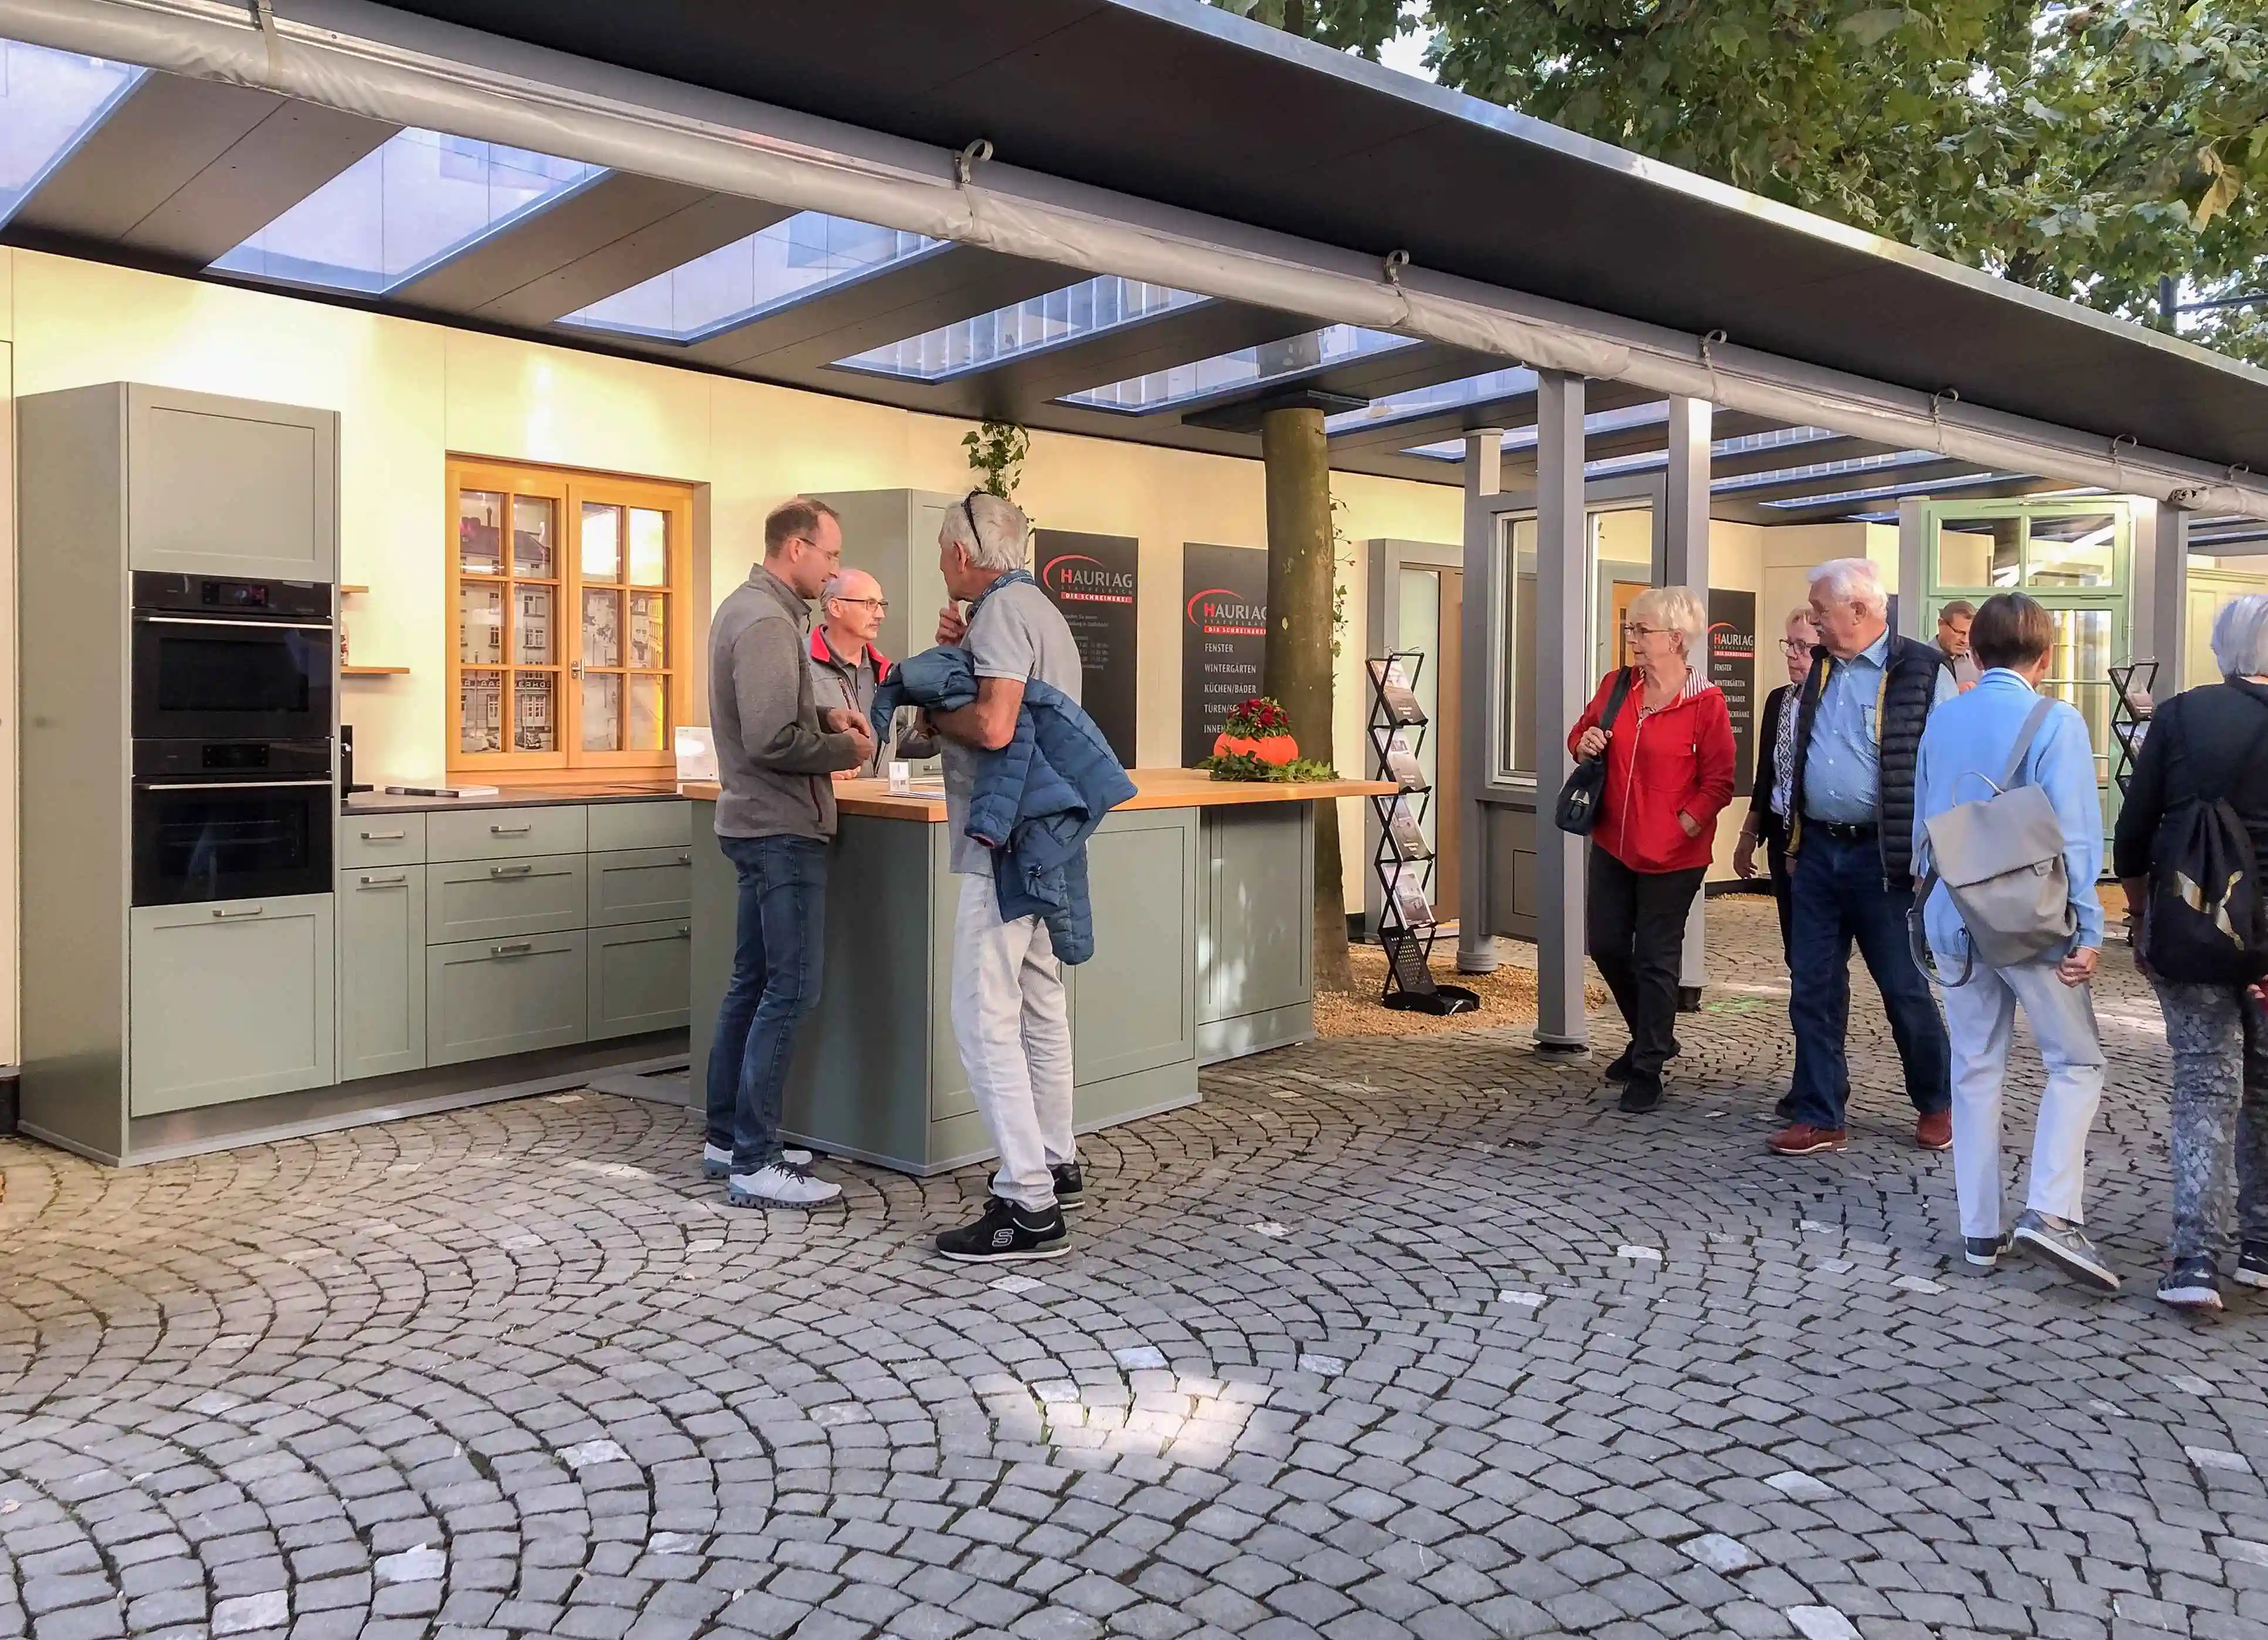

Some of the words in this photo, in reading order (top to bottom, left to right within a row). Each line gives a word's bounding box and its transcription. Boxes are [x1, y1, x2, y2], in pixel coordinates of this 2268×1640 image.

[1061, 568, 1110, 587] HAURI
[1112, 572, 1133, 588] AG
[1204, 602, 1249, 619] HAURI
[1714, 633, 1741, 646] HAURI
[1742, 635, 1754, 646] AG
[1204, 643, 1234, 653] FENSTER
[1204, 662, 1257, 674] WINTERGÄRTEN
[1204, 682, 1257, 694] KÜCHEN/BÄDER
[992, 1228, 1014, 1247] S
